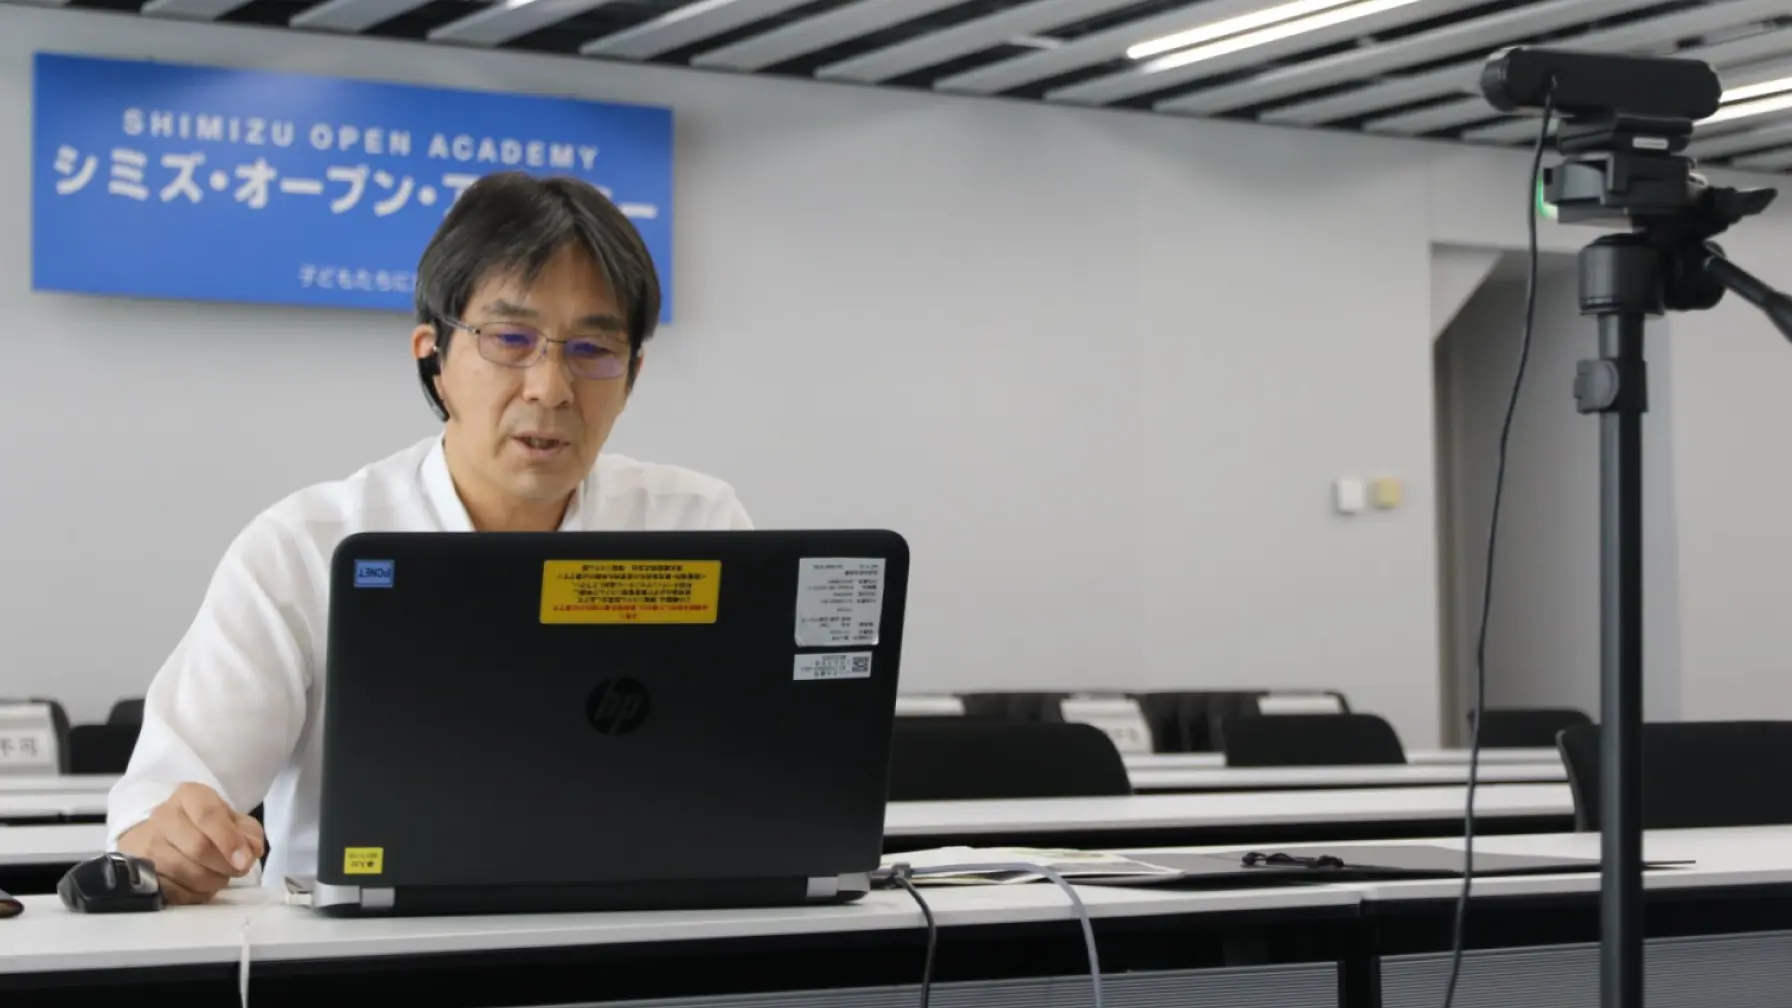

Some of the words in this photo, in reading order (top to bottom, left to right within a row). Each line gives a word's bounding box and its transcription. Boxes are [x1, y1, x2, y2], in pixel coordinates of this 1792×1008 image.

[123, 108, 295, 148] SHIMIZU
[309, 122, 412, 157] OPEN
[427, 132, 599, 171] ACADEMY
[299, 262, 417, 294] 子どもたちに
[593, 679, 646, 736] hp
